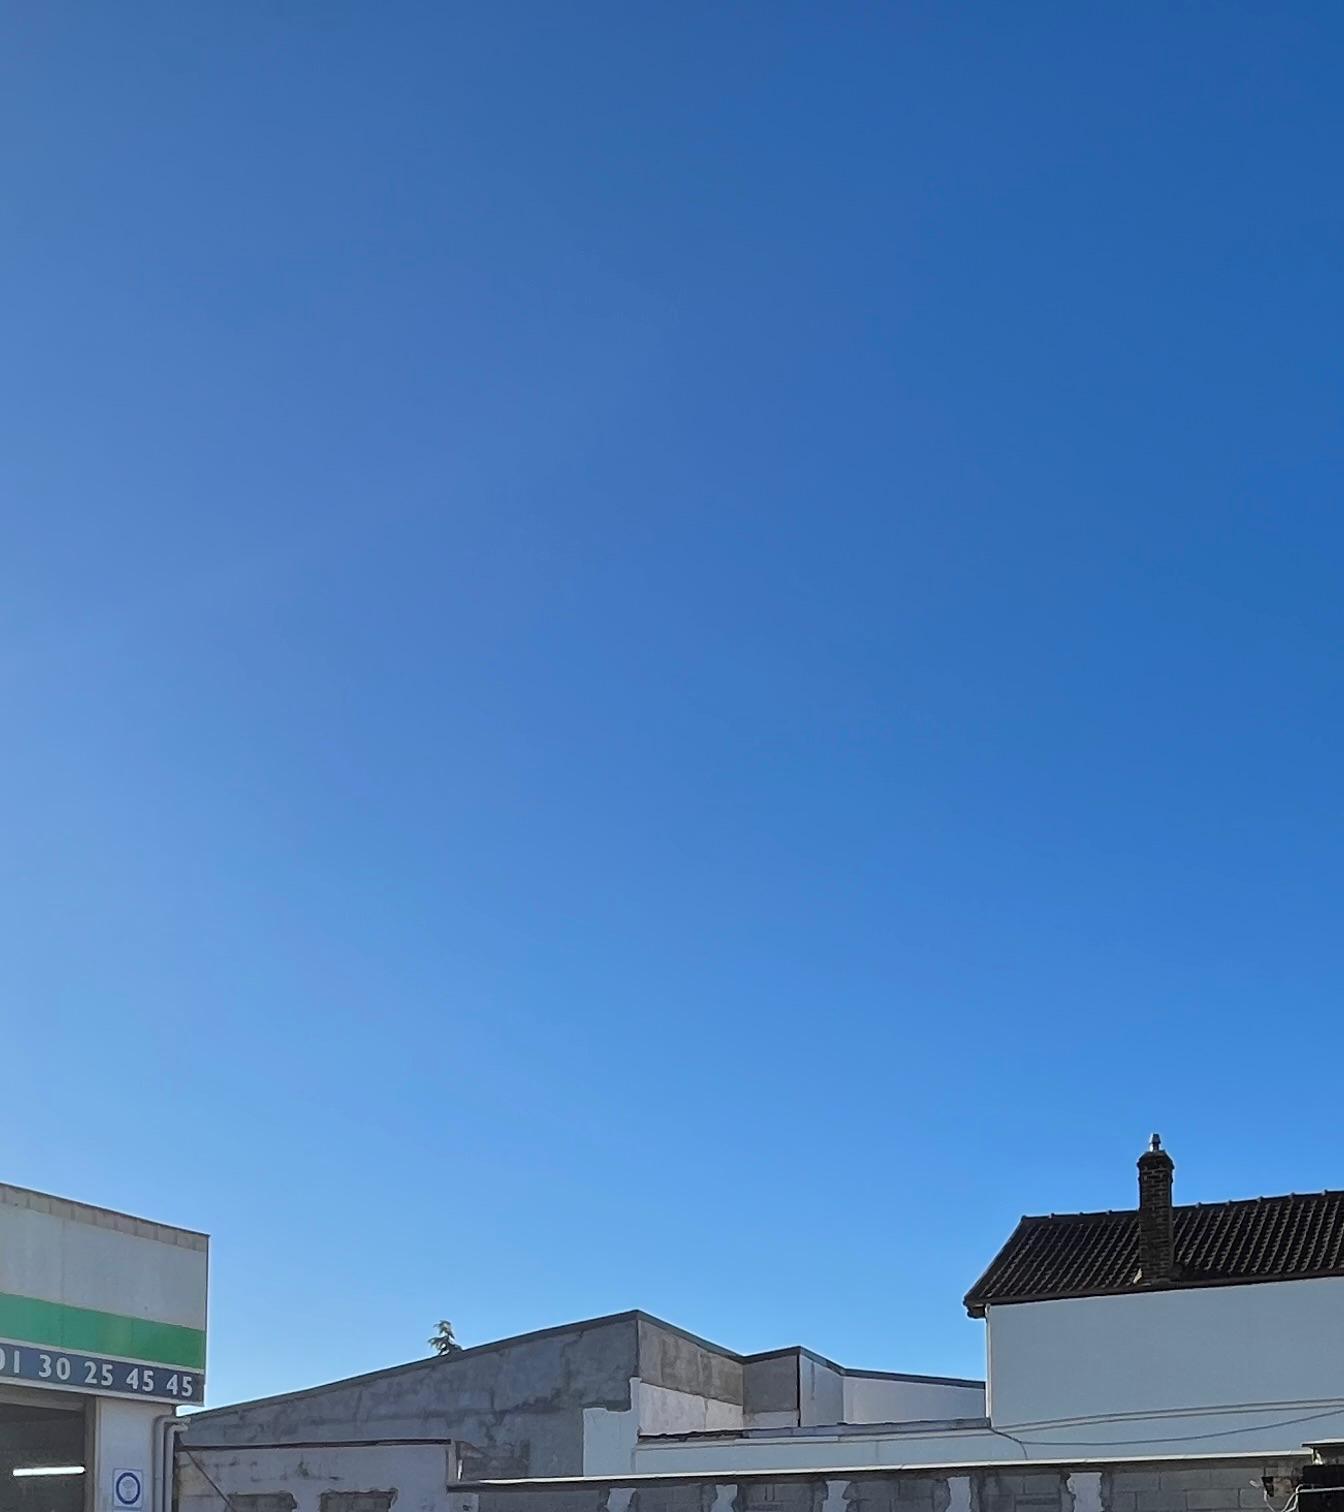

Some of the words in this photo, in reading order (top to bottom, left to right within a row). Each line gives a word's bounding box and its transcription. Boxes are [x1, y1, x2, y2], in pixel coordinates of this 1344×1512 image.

[38, 1353, 72, 1381] 30
[84, 1361, 114, 1386] 25
[125, 1369, 156, 1392] 45
[166, 1373, 194, 1397] 45
